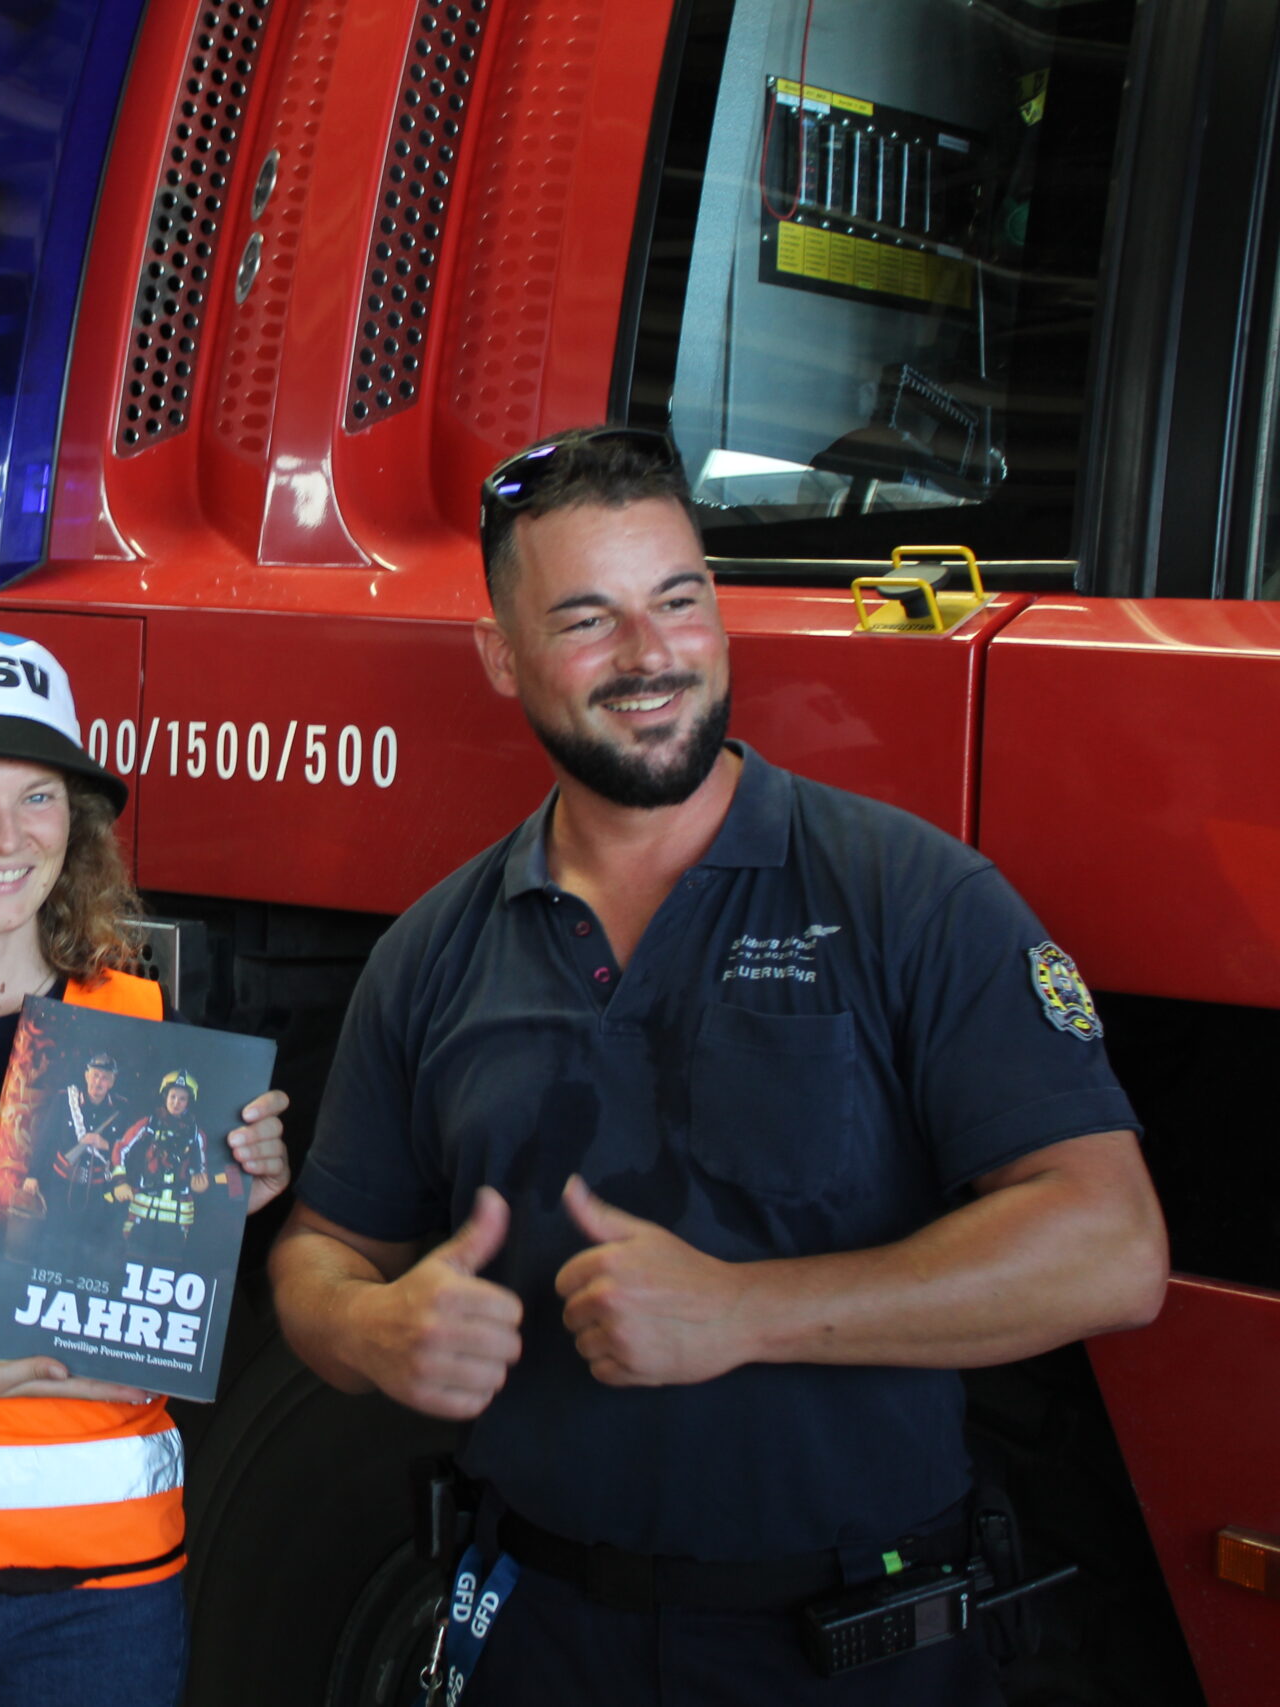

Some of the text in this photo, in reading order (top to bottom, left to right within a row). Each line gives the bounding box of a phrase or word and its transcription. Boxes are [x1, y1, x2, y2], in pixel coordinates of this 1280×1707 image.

[80, 716, 399, 788] 00/1500/500
[31, 1267, 63, 1286] 1875
[76, 1276, 110, 1294] 2025
[121, 1262, 206, 1311] 150
[14, 1284, 201, 1356] JAHRE
[53, 1336, 193, 1372] Freiwillige Feuerwehr Lauenburg
[452, 1571, 477, 1623] GFD
[470, 1591, 500, 1639] GFD
